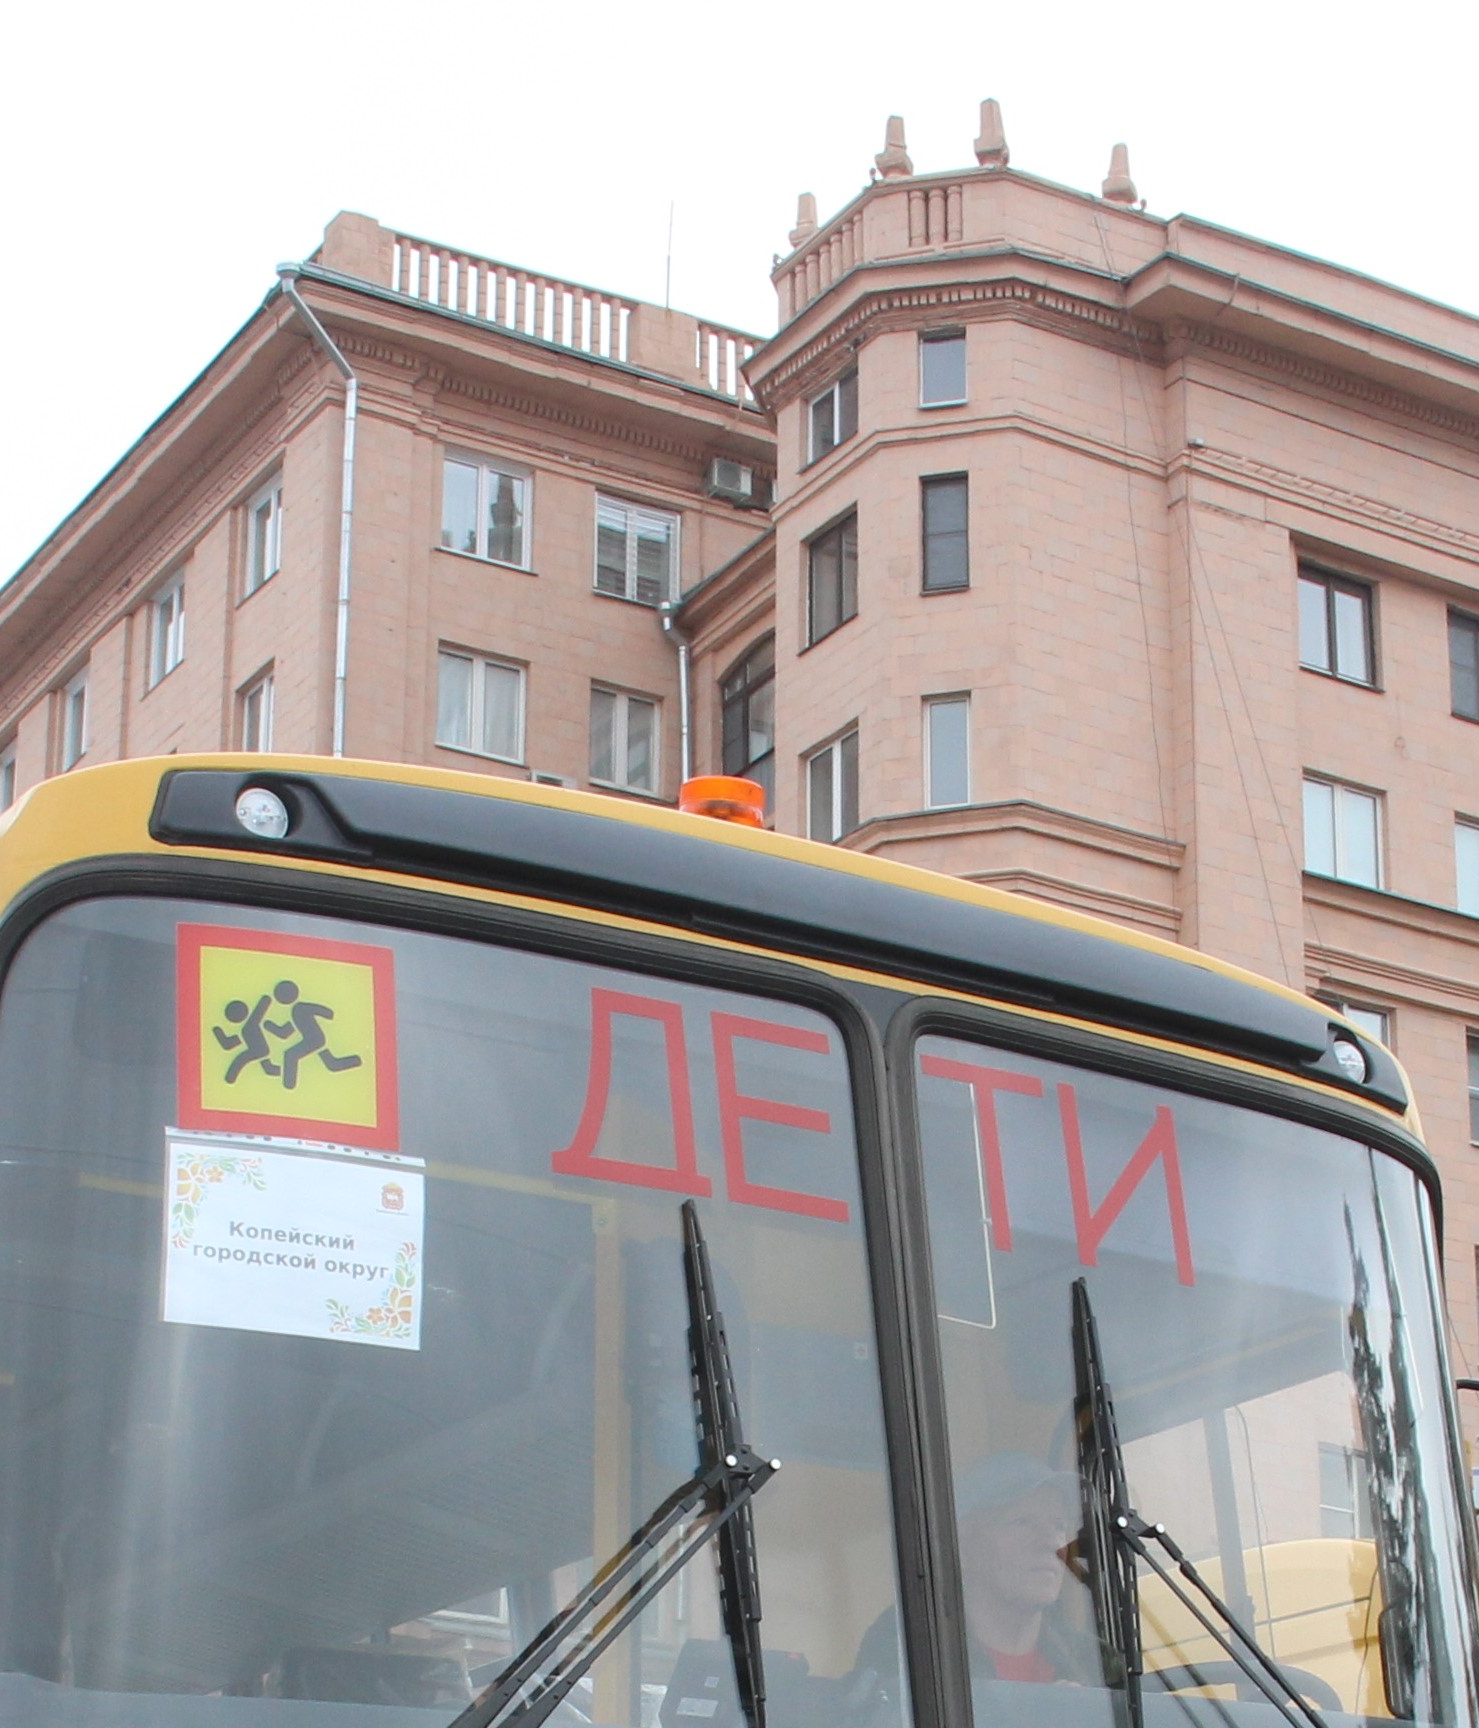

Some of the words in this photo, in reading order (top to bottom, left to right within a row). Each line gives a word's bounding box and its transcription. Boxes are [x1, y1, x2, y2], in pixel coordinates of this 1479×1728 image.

[229, 1220, 355, 1251] Копейский
[193, 1243, 317, 1270] городской
[324, 1257, 389, 1282] округ
